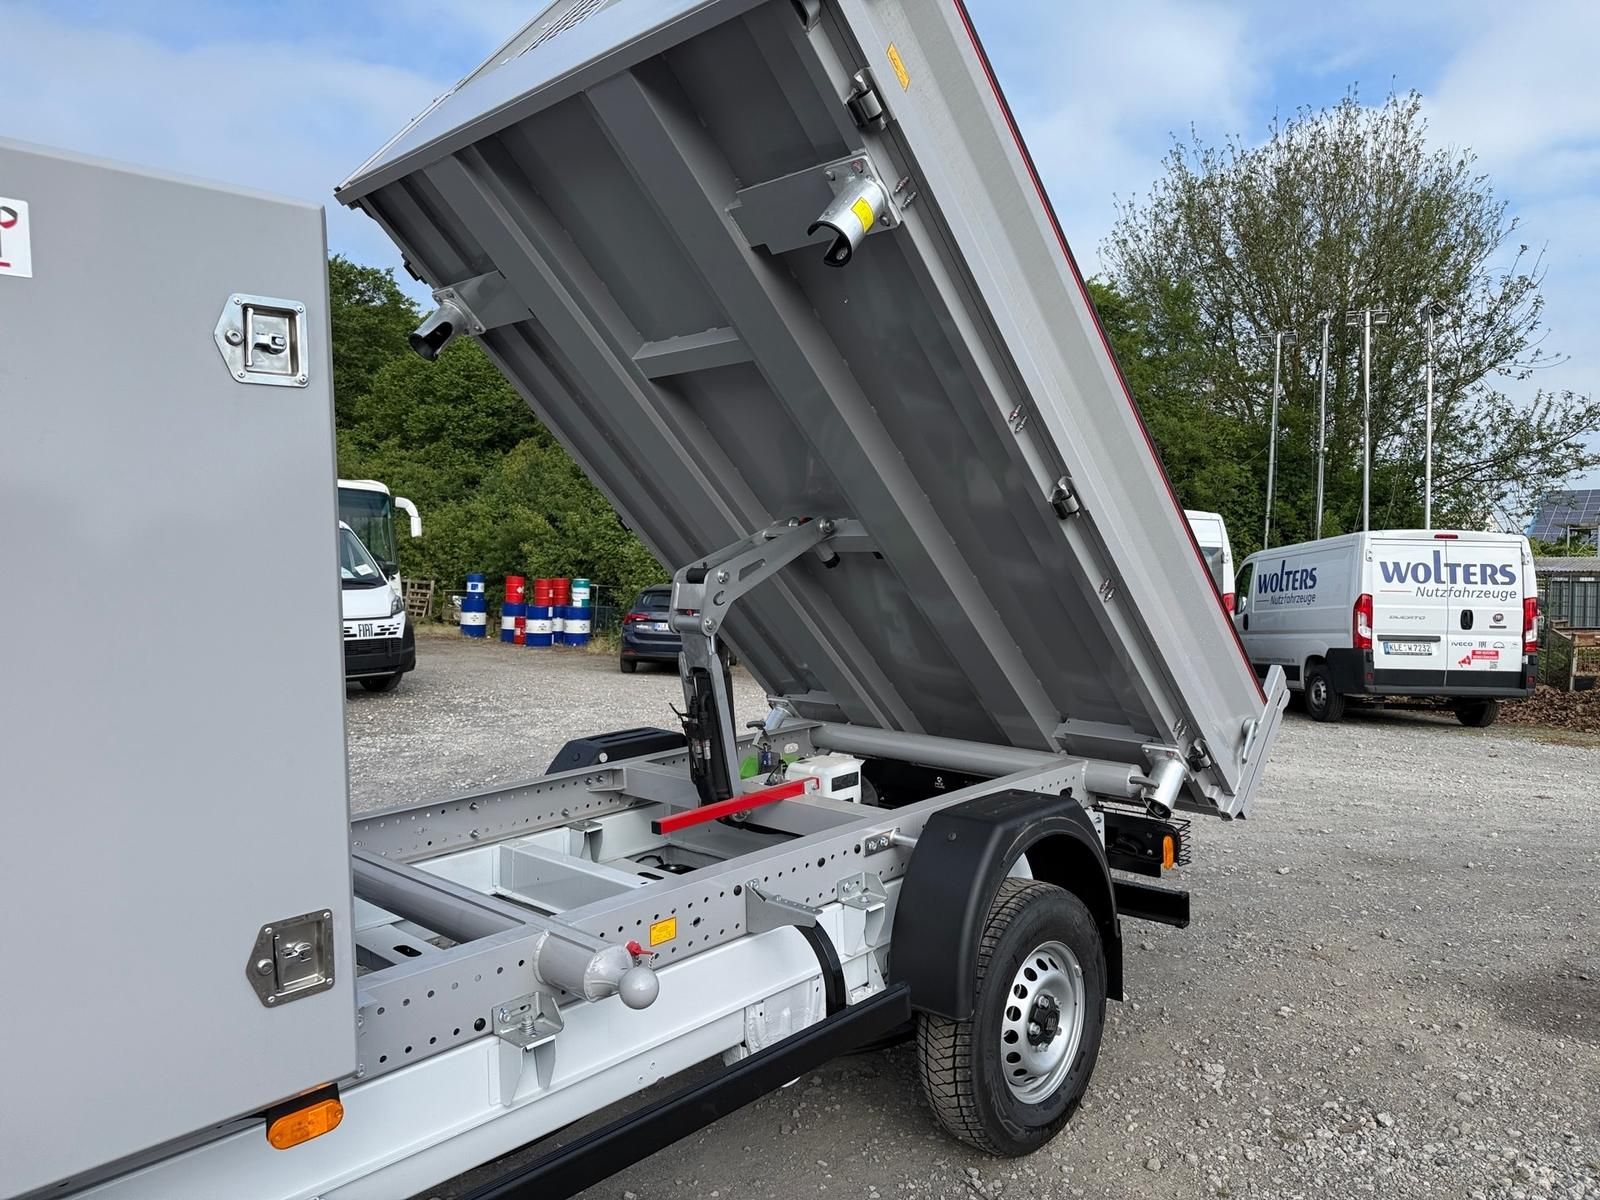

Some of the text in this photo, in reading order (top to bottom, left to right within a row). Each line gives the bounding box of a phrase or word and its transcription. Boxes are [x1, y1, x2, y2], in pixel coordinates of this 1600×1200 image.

[1270, 593, 1316, 606] Nutzfahrzeuge
[1415, 586, 1517, 602] Nutzfahrzeuge
[357, 623, 374, 638] FIAT
